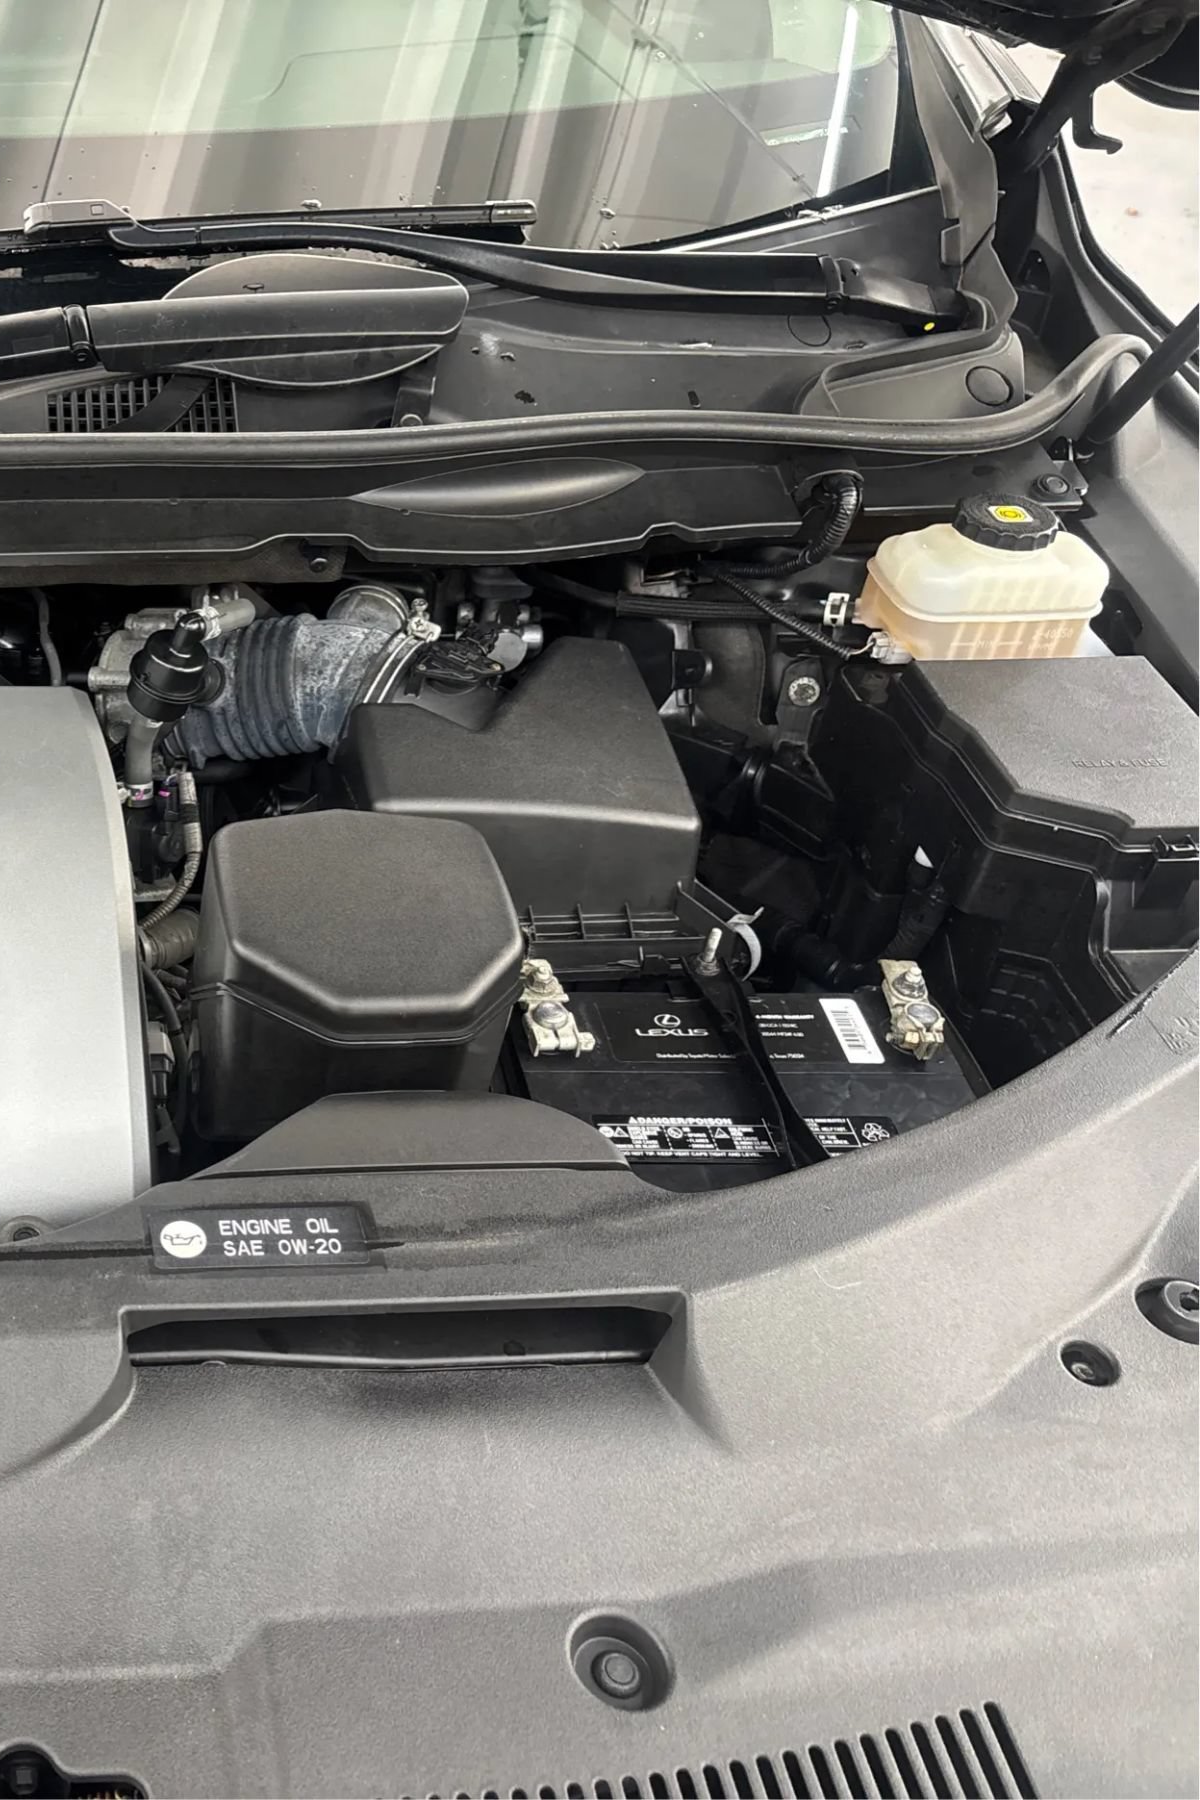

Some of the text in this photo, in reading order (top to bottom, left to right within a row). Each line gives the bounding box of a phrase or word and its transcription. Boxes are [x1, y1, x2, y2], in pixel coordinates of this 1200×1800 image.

[1072, 759, 1116, 769] RELAY
[1131, 758, 1169, 768] FUSE
[634, 1028, 709, 1037] LEXUS
[218, 1217, 339, 1236] ENGINE OIL
[223, 1238, 343, 1257] SAE 0W-20
